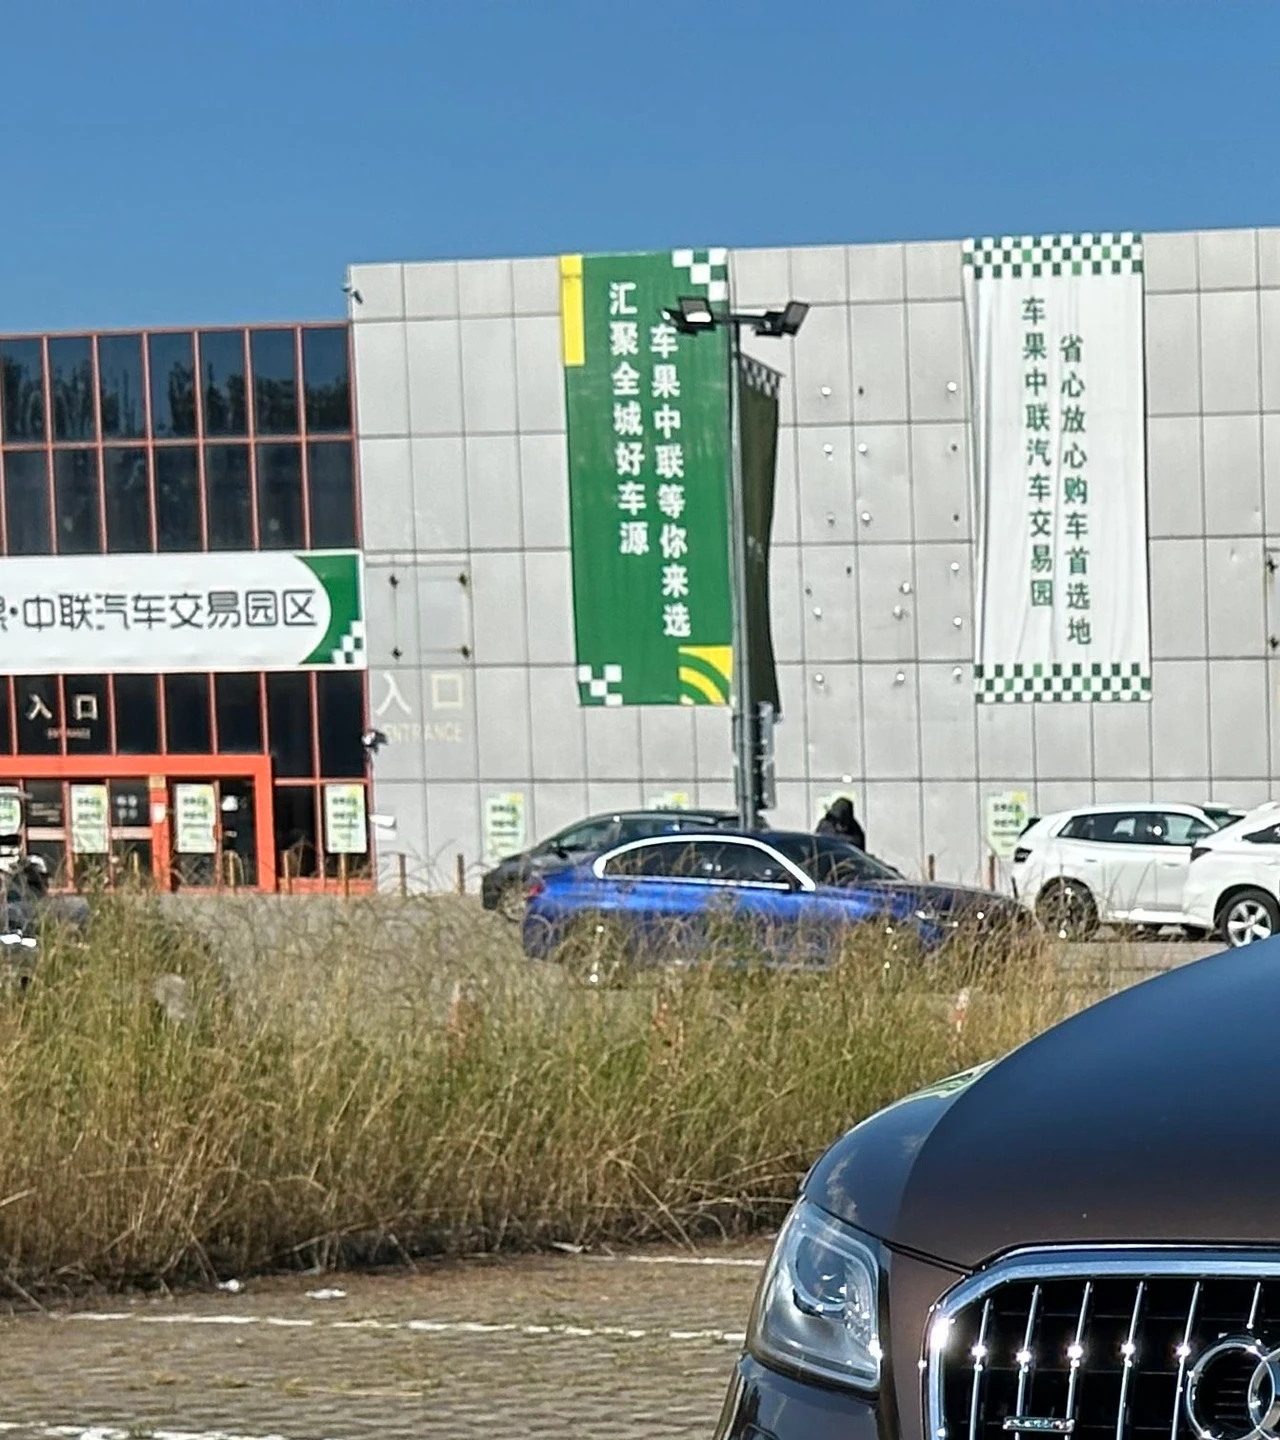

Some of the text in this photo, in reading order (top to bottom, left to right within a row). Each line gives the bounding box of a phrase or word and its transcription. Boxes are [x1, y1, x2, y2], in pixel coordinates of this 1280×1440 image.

[609, 281, 650, 556] 汇聚全城好车源
[650, 323, 691, 637] 车果中联等你来选
[1021, 296, 1053, 608] 车果中联汽车交易园
[1059, 334, 1092, 646] 省心放心购车首选地
[0, 588, 318, 631] ·中联汽车交易园区
[26, 694, 98, 721] 入口
[375, 671, 463, 716] 入口
